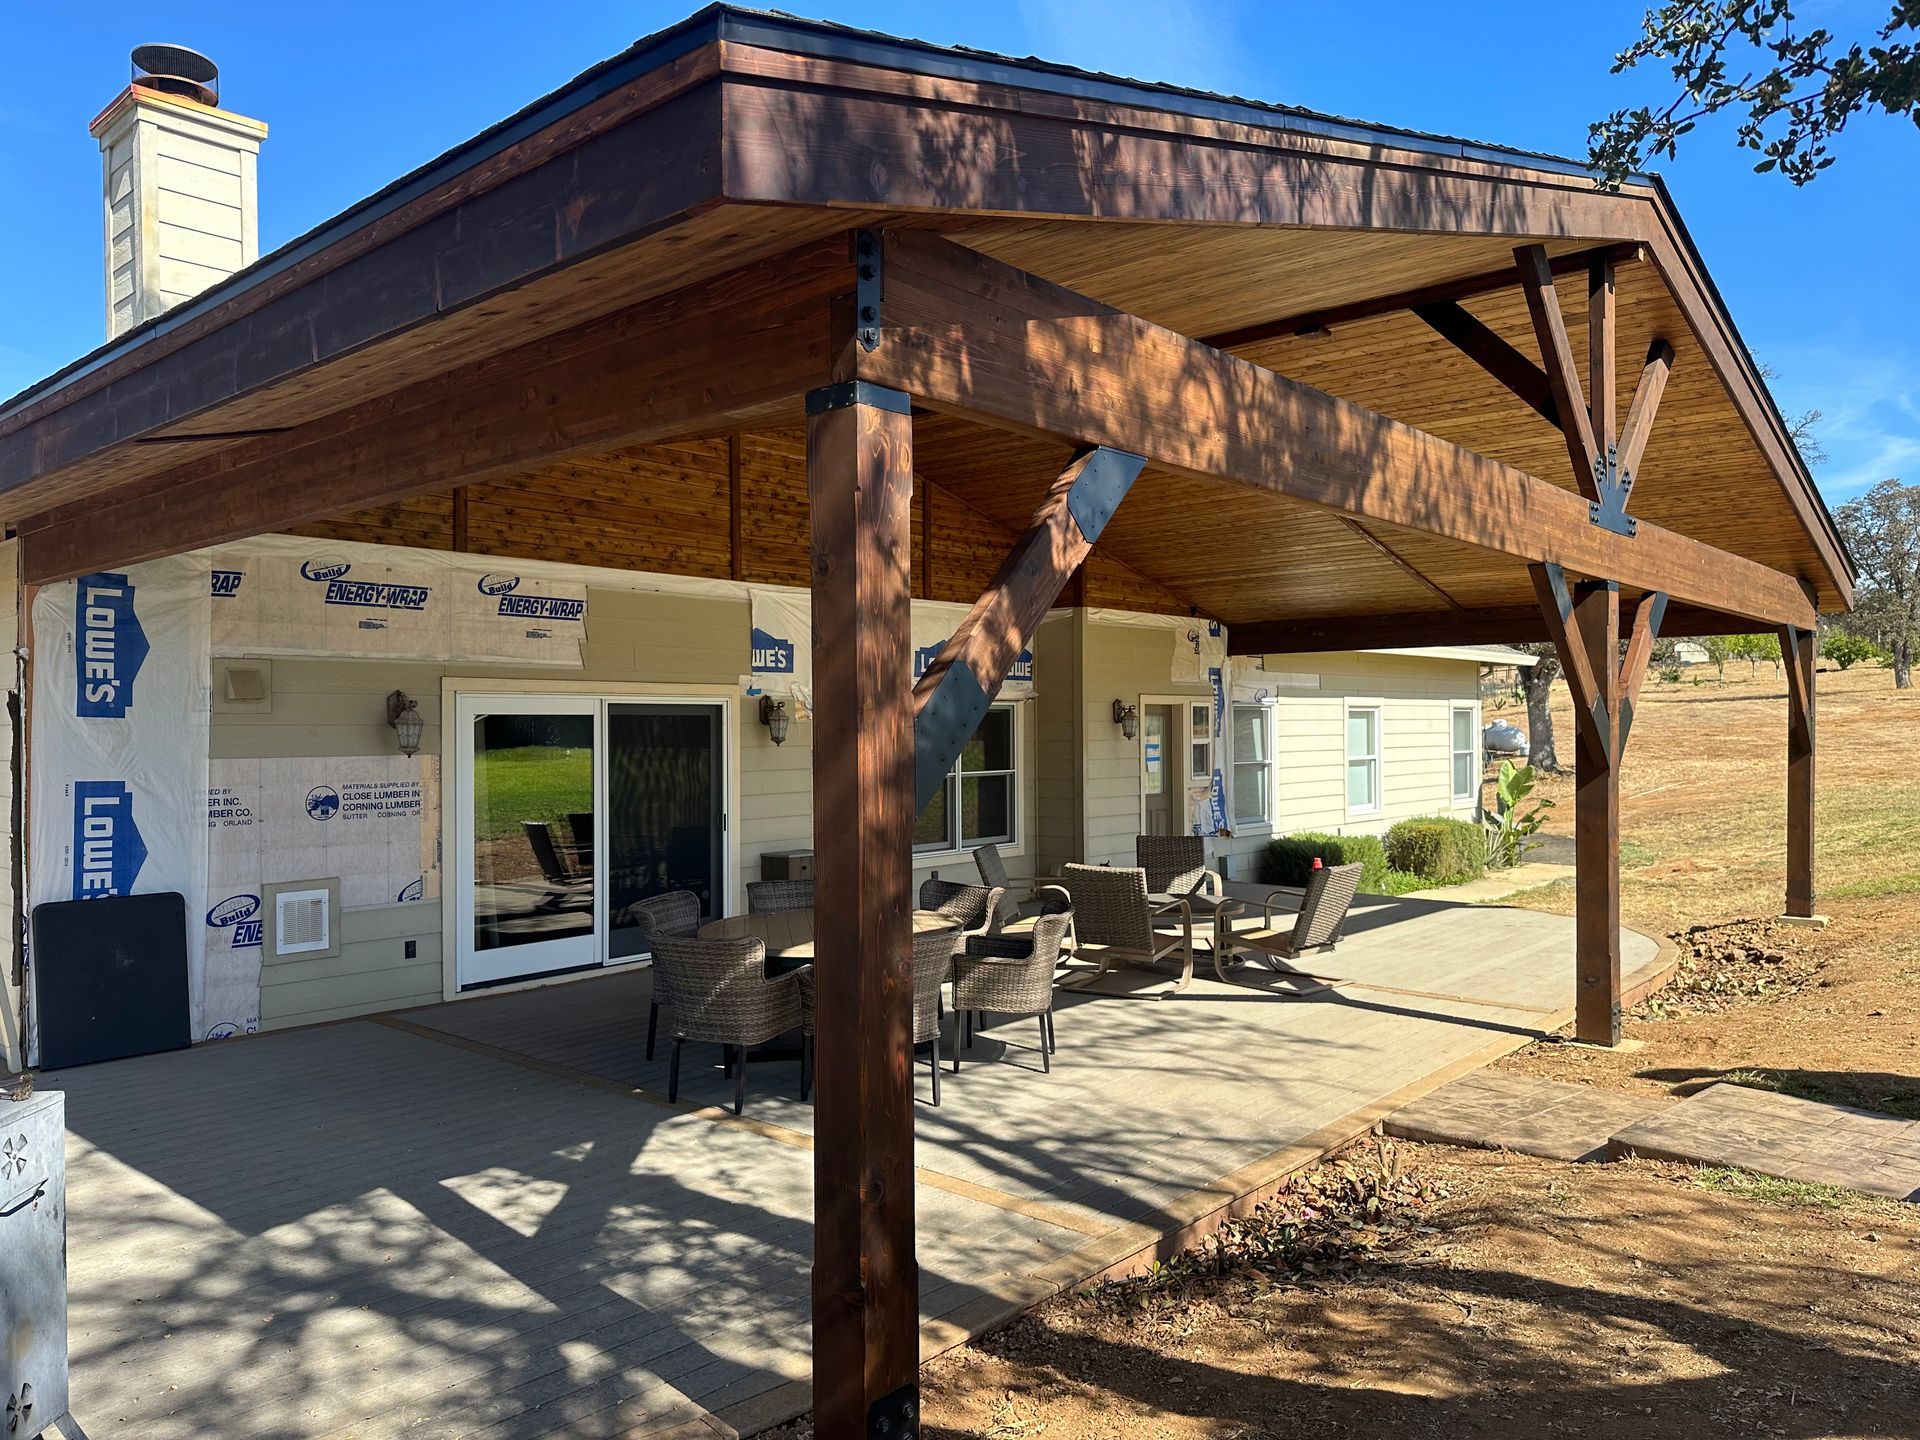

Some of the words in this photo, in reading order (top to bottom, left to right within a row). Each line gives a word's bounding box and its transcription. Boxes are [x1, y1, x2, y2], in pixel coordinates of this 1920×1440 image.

[313, 567, 343, 580] Build
[488, 582, 512, 595] Build
[85, 587, 123, 702] LOWE'S
[379, 781, 412, 789] SUPPLIED
[342, 792, 372, 801] CLOSE
[374, 790, 410, 800] LUMBER
[223, 797, 242, 806] INC.
[342, 802, 384, 811] CORNING
[385, 800, 420, 809] LUMBER
[235, 808, 253, 817] CO.
[342, 812, 368, 820] SUTTER
[377, 810, 407, 818] CORNING
[223, 819, 253, 827] ORLAND
[82, 797, 120, 900] LOWE'
[220, 907, 251, 926] Build
